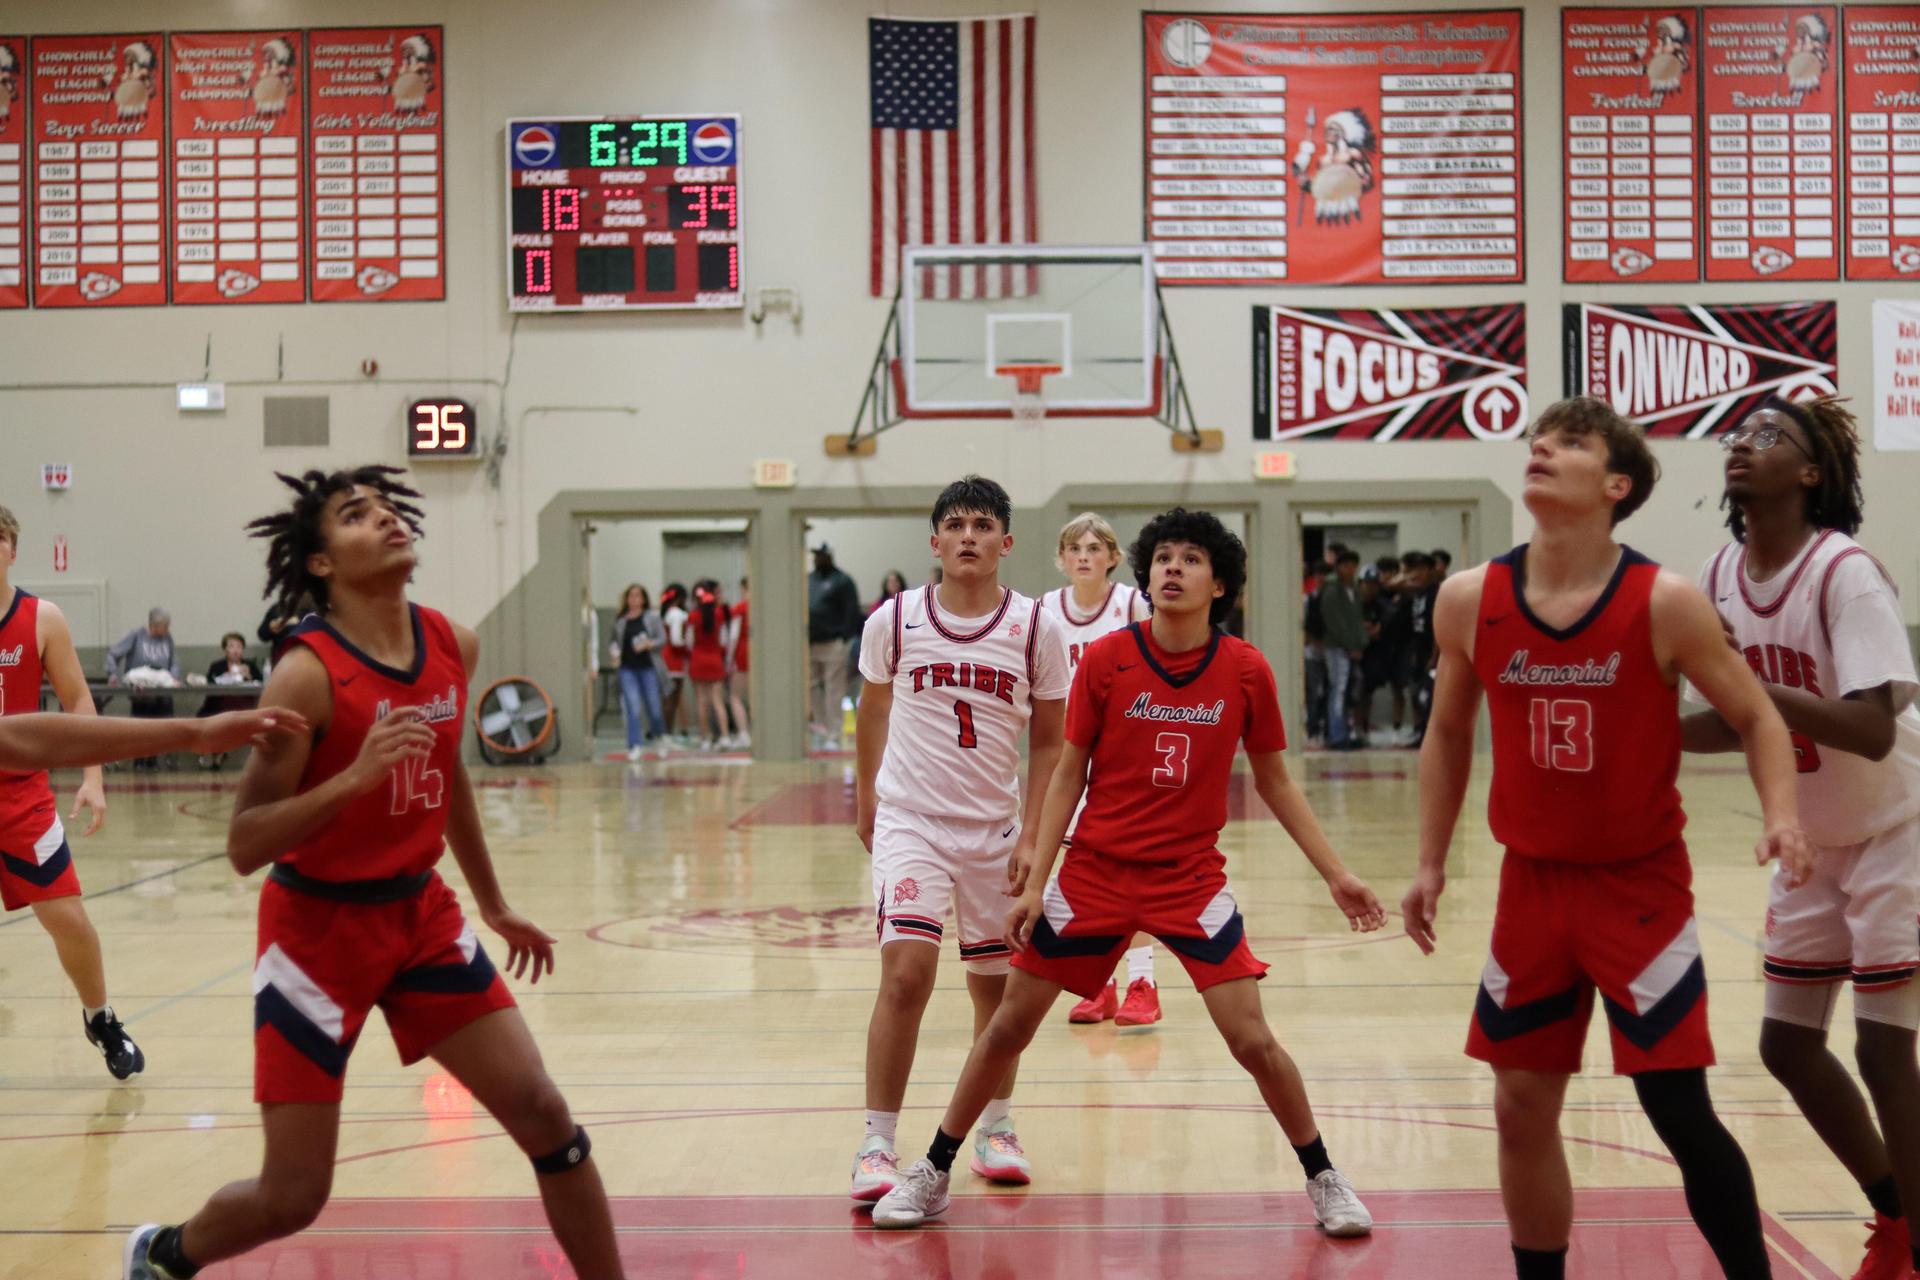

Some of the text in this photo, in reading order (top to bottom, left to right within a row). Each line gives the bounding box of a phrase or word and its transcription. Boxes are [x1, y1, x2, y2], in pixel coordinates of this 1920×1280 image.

[1850, 21, 1920, 33] CHOWCHILL
[1853, 62, 1920, 74] CHAMPION
[1589, 92, 1664, 109] Football
[1731, 90, 1804, 108] Baseball
[1873, 89, 1920, 107] Softb
[45, 118, 145, 138] Boys Soccer
[192, 116, 276, 135] Wrestling
[313, 112, 438, 131] Girls Volleyball
[87, 145, 111, 155] 2012
[590, 122, 687, 166] 6:29
[521, 170, 570, 185] HOME
[600, 171, 647, 184] PERIOD
[673, 166, 731, 183] GUEST
[542, 188, 579, 231] 18
[602, 213, 647, 227] BONUS
[681, 185, 737, 229] 39
[512, 234, 553, 247] FOULS
[579, 232, 629, 246] PLAYER
[643, 231, 676, 244] FOUL
[47, 271, 71, 280] 2011
[526, 250, 551, 292] 0
[729, 246, 738, 289] 1
[1280, 325, 1296, 420] REDSKINS
[1301, 324, 1440, 419] FOCUS
[1590, 322, 1606, 401] DSKINS
[1610, 323, 1750, 417] ONWARD
[1887, 393, 1907, 417] Hail
[416, 404, 466, 449] 35
[1498, 649, 1620, 687] Memorial
[1742, 643, 1825, 699] RIBE
[908, 662, 1017, 706] TRIBE
[1125, 692, 1224, 727] Memorial
[953, 700, 977, 750] 1
[1528, 698, 1593, 773] 13
[1152, 731, 1190, 790] 3
[391, 743, 444, 815] 14
